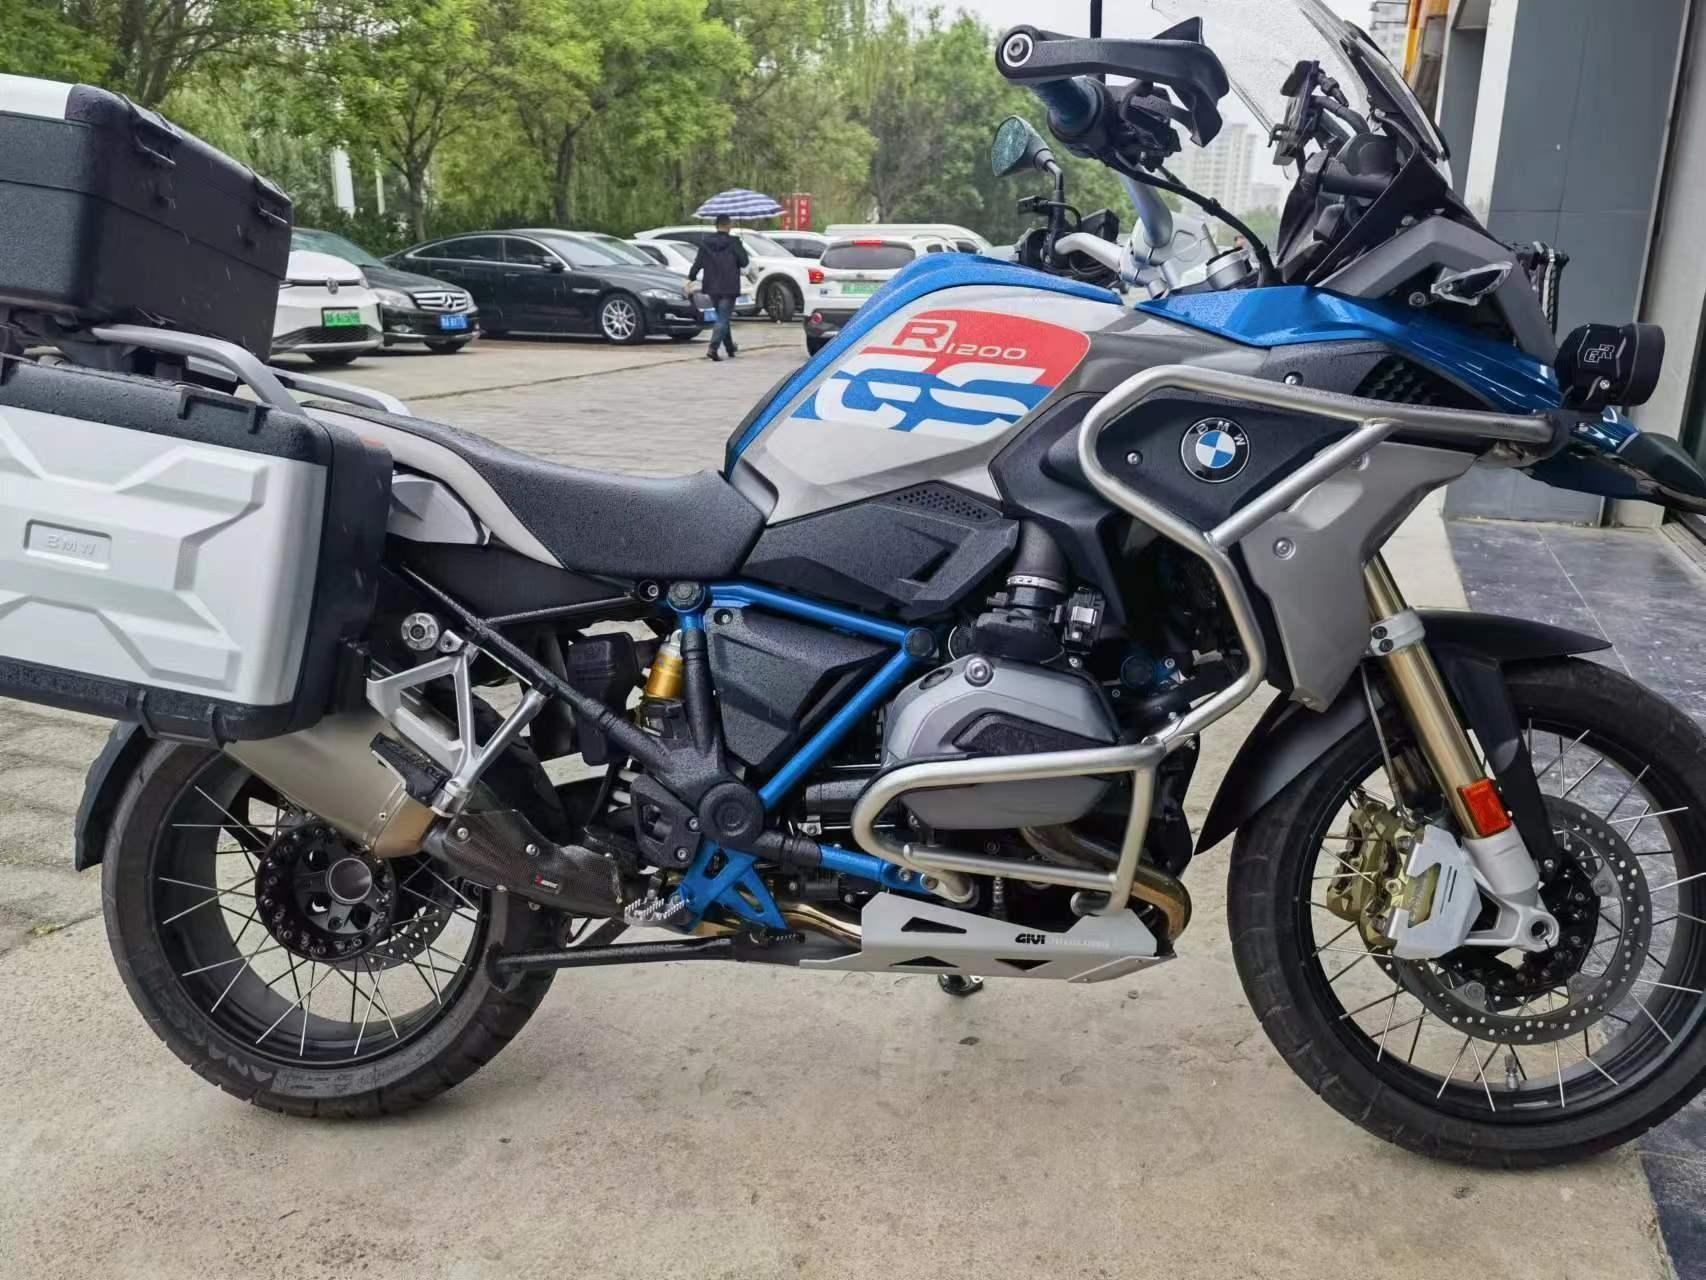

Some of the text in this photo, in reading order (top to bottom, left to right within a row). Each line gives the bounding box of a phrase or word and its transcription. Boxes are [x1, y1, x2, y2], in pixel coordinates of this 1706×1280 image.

[814, 352, 1047, 443] GS
[1196, 420, 1246, 446] BMW
[47, 534, 97, 555] BMW
[1015, 933, 1046, 945] GIVI
